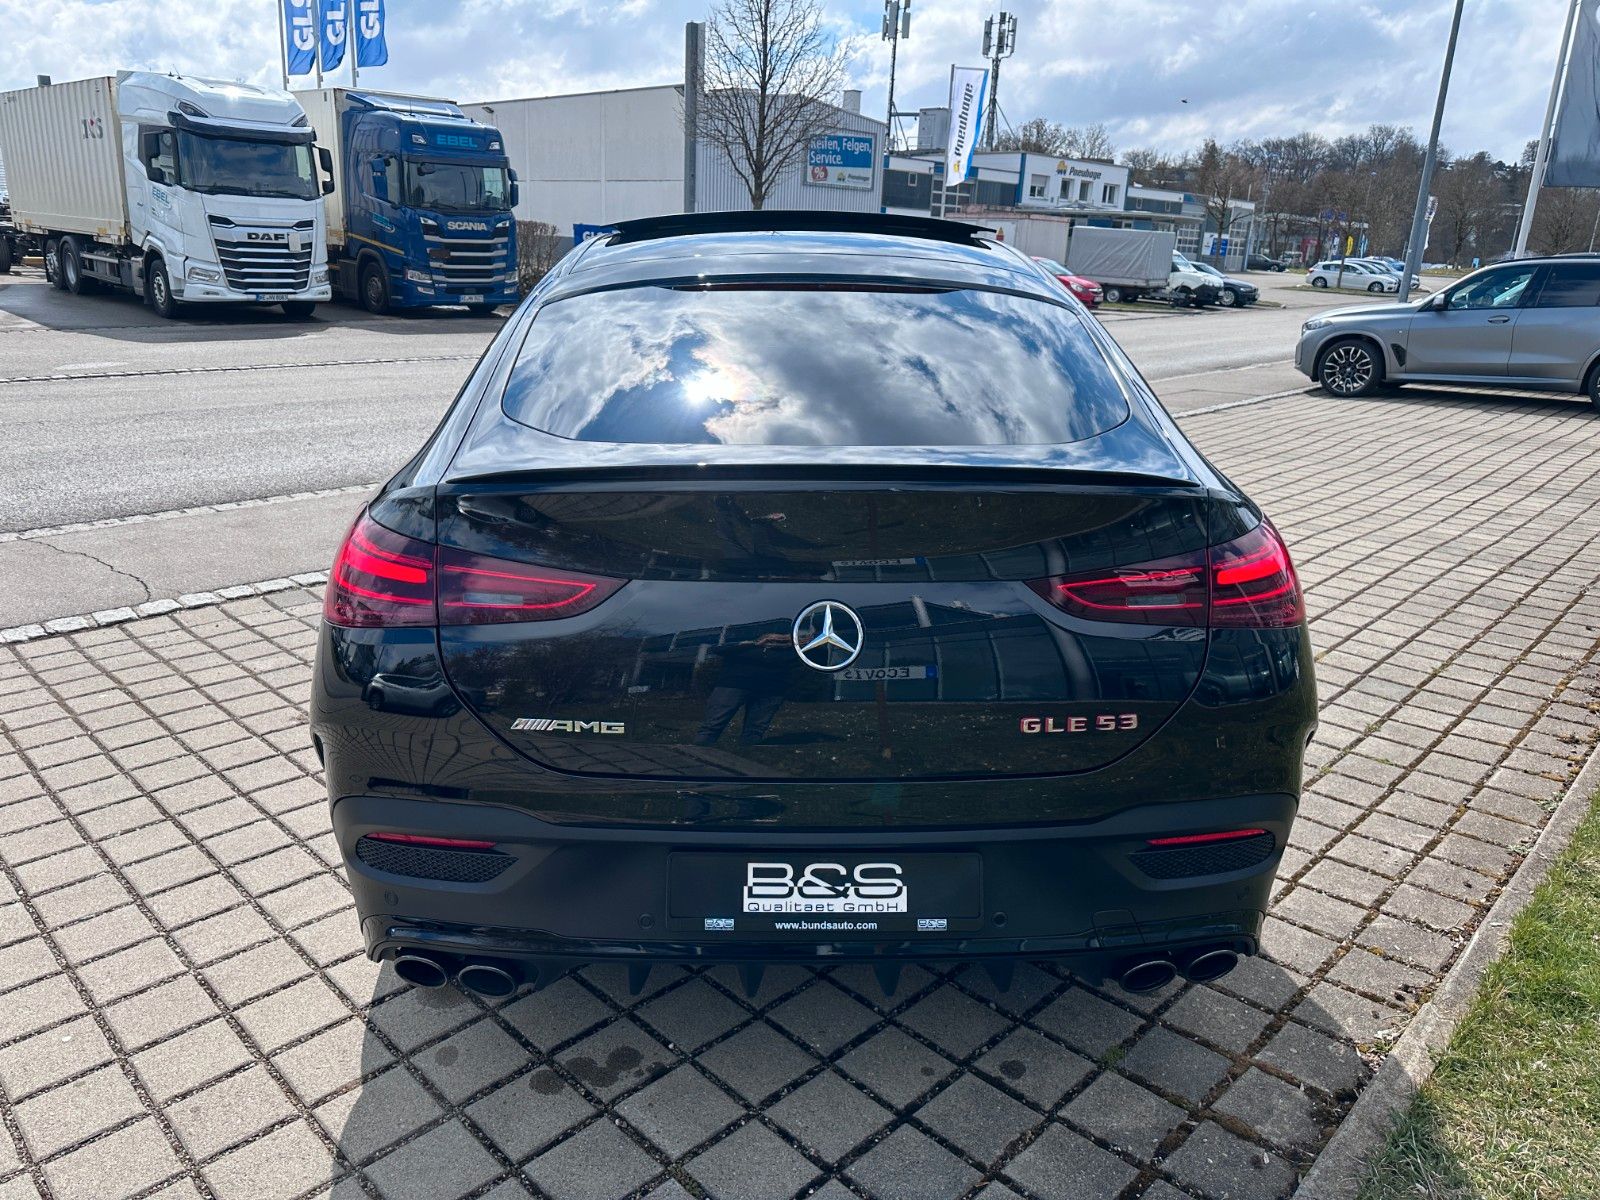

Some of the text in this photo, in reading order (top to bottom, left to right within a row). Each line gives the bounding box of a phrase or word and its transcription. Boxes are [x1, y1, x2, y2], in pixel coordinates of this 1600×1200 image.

[326, 0, 346, 46] GL
[954, 83, 973, 157] Pneuhage
[437, 134, 478, 148] EBEL
[811, 136, 872, 155] Reifen, Felgen,
[810, 150, 843, 165] Service.
[1069, 166, 1102, 181] Pneuhage
[447, 221, 488, 231] SCANIA
[247, 232, 285, 241] DAF
[547, 719, 625, 734] AMG
[1020, 713, 1138, 735] GLE 53
[747, 862, 903, 899] B&S
[748, 901, 835, 912] Qualitaet
[775, 920, 878, 930] www.bundsauto.com
[919, 919, 947, 929] B&S
